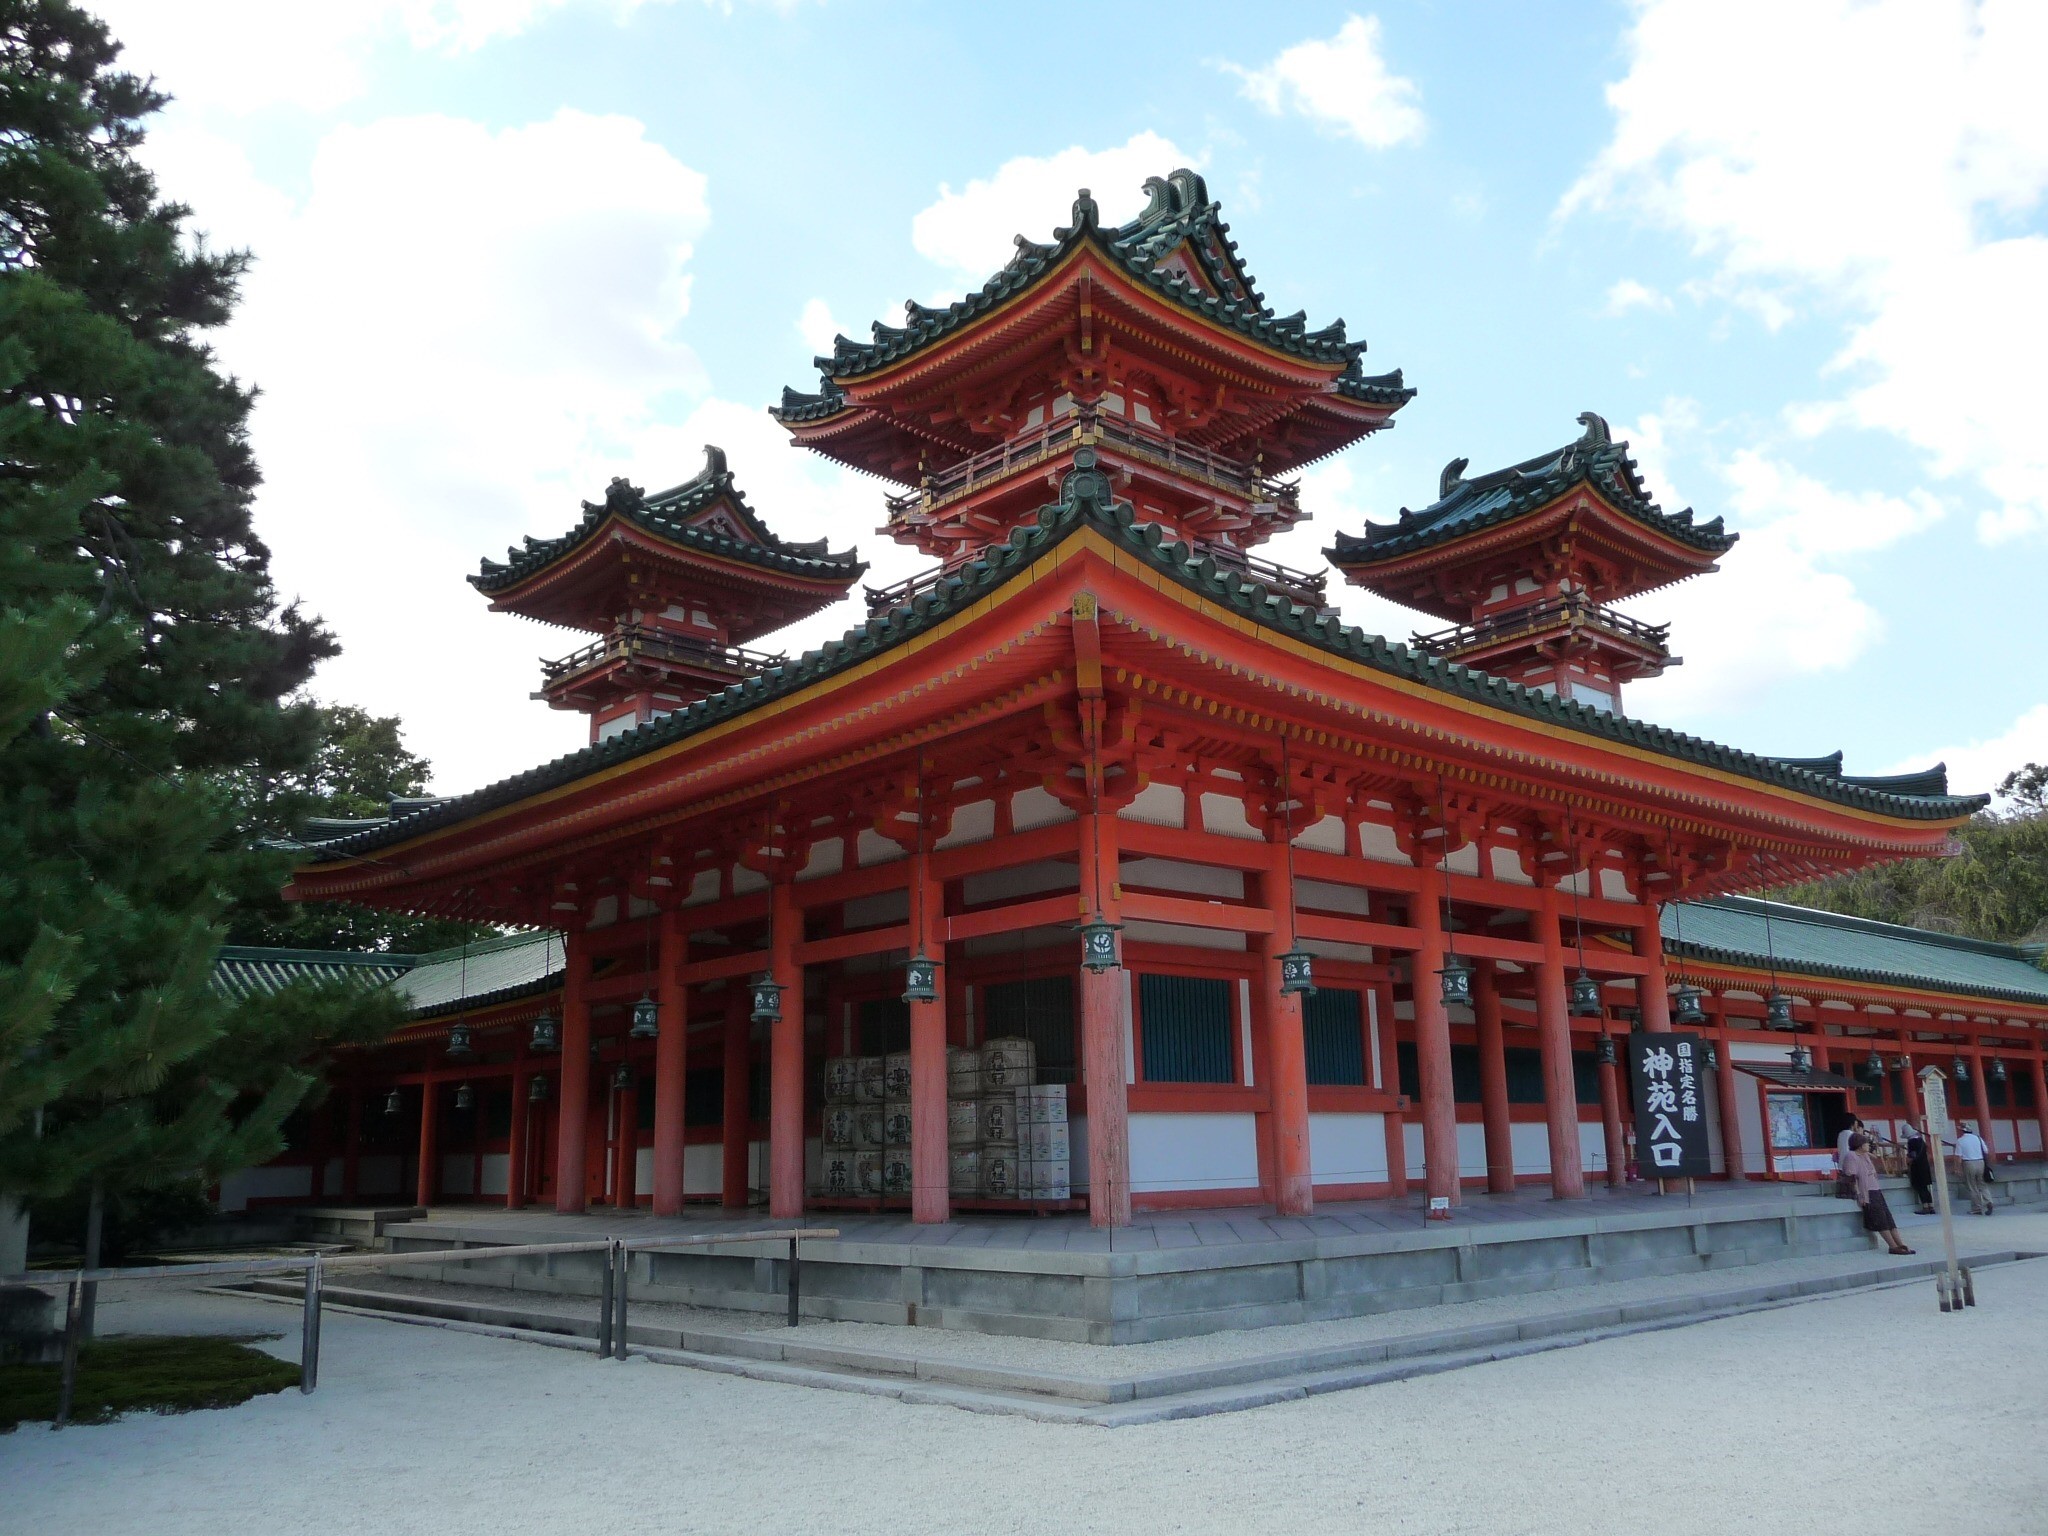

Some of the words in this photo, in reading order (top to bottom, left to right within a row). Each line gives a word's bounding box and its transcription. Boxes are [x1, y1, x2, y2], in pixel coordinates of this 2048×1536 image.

[1643, 1047, 1682, 1166] 神苑入口
[1677, 1042, 1698, 1121] 国指定名勝
[990, 1106, 1005, 1140] 月桂冠
[990, 1160, 1006, 1194] 月桂冠
